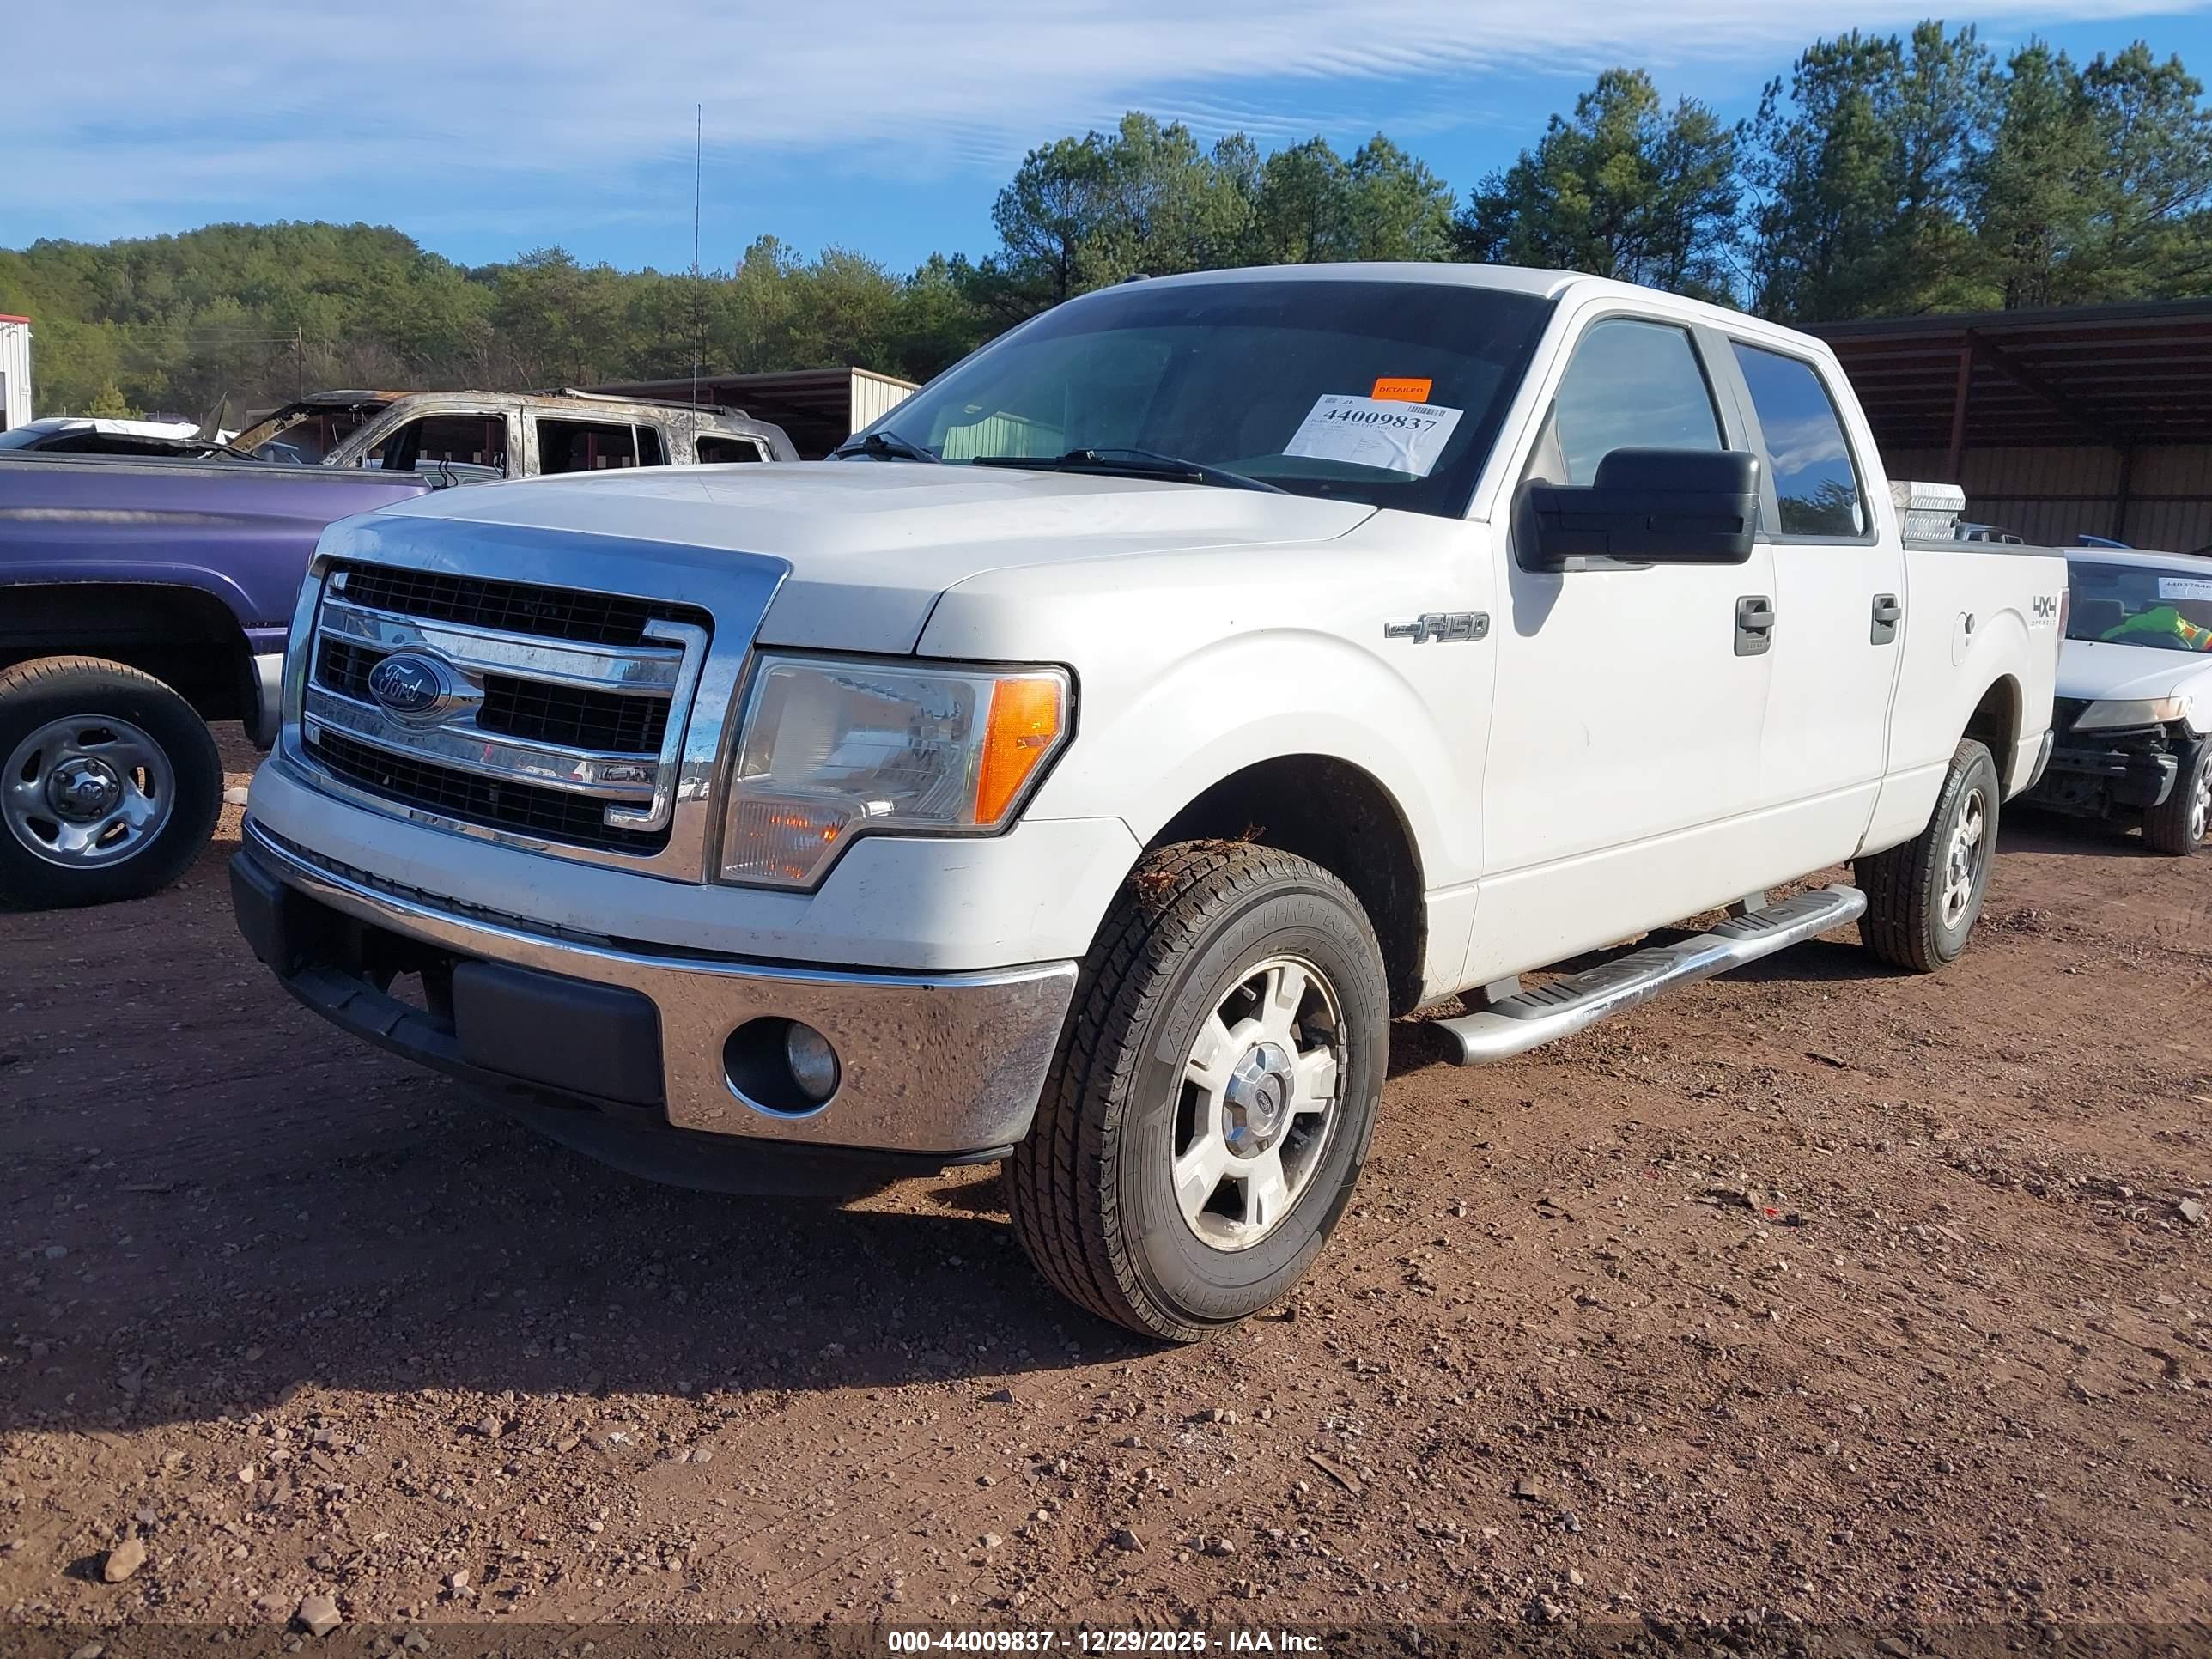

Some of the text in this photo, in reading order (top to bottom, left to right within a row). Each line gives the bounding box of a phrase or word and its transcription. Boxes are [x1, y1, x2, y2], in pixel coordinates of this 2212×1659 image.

[1378, 386, 1424, 394] DETAILED
[1323, 409, 1437, 432] 44009837
[378, 663, 423, 710] Ford
